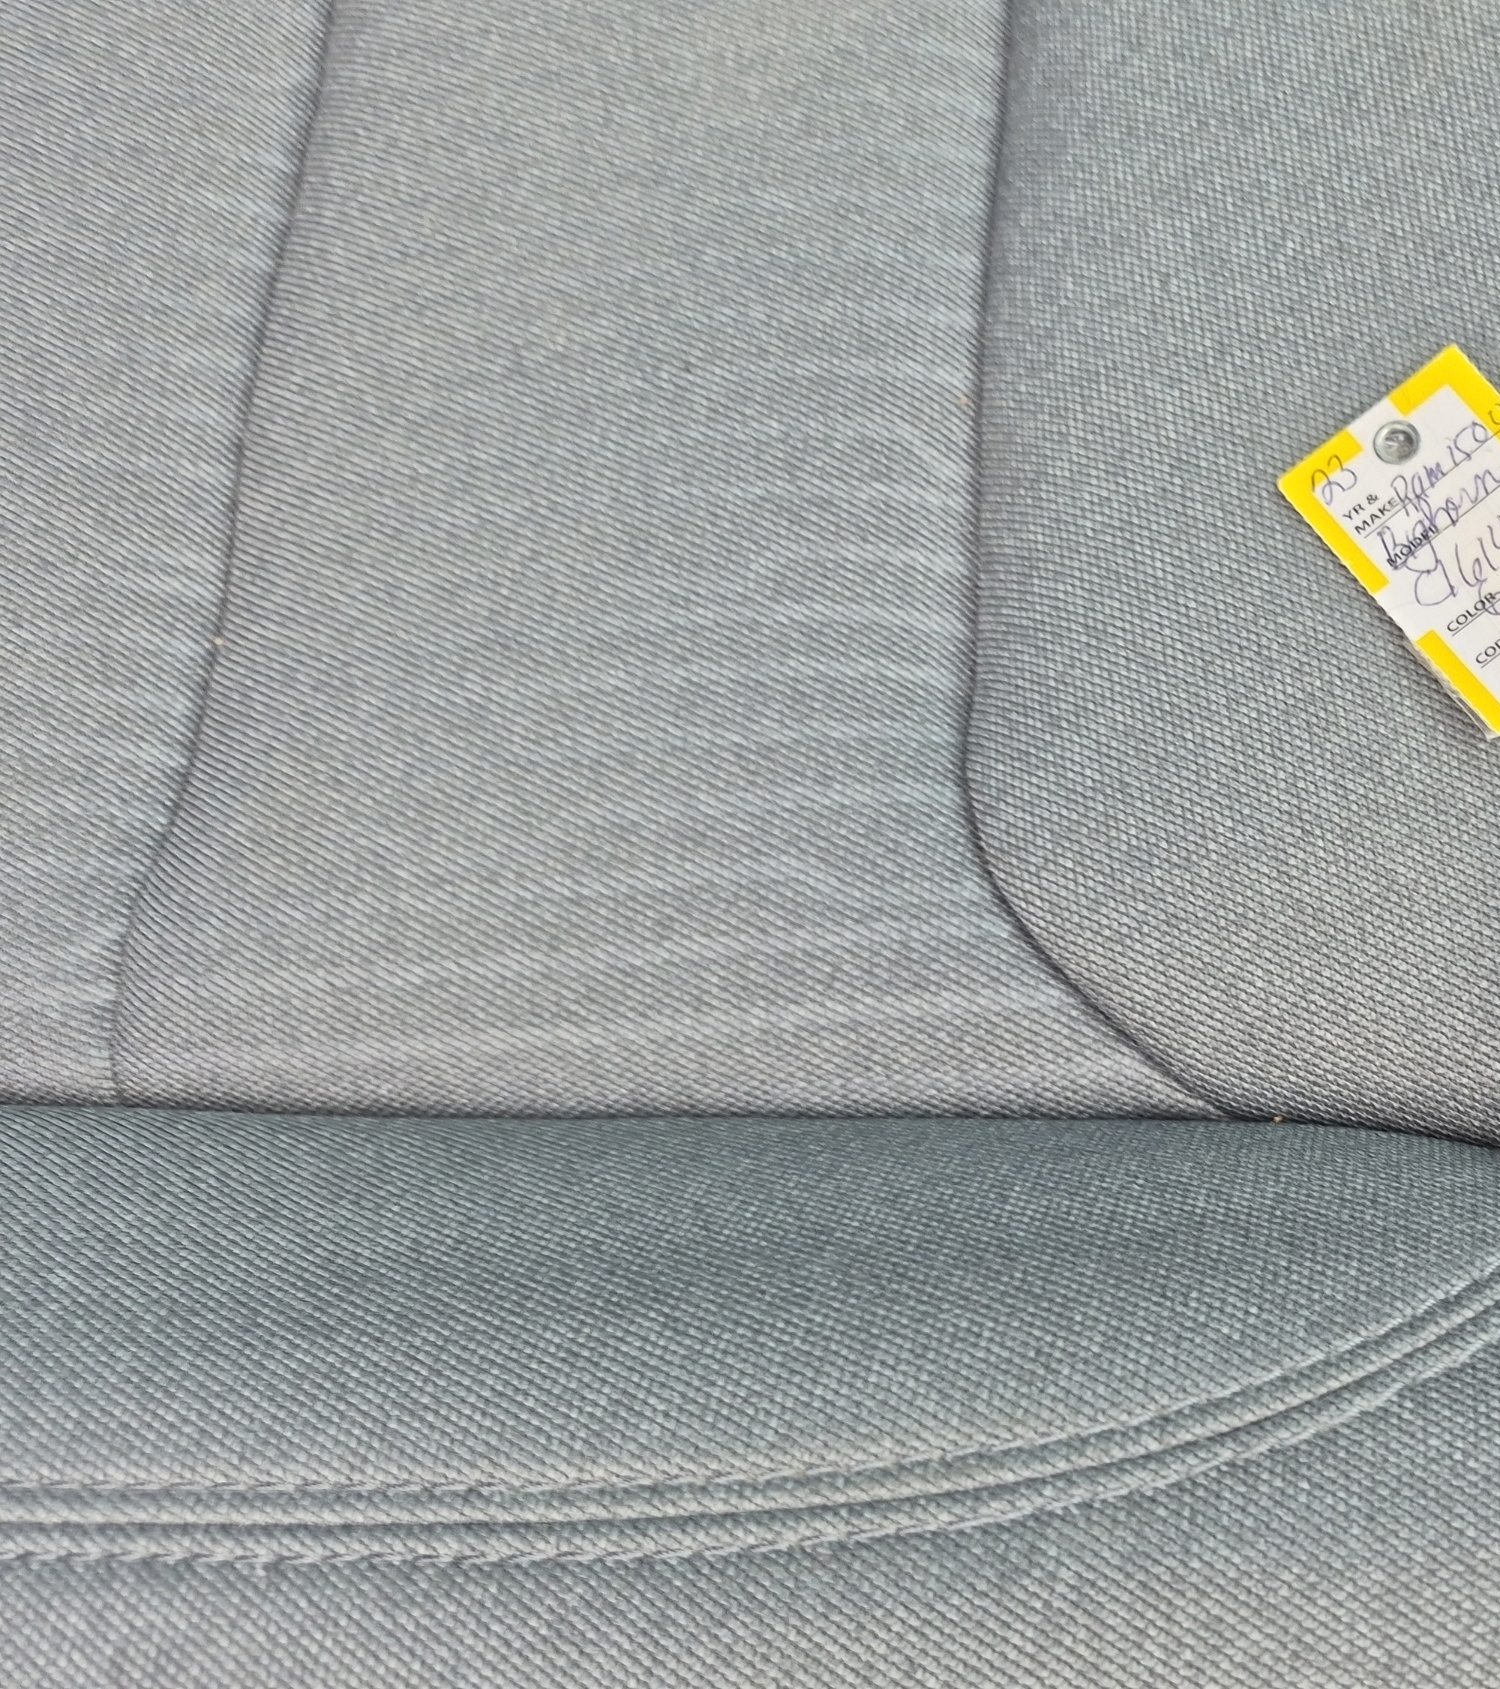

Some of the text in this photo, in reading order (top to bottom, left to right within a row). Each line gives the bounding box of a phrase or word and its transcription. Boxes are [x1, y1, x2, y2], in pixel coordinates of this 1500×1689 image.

[1311, 454, 1358, 505] 23
[1342, 493, 1378, 521] YR &
[1355, 497, 1401, 535] MAKE
[1446, 591, 1497, 633] COLOR
